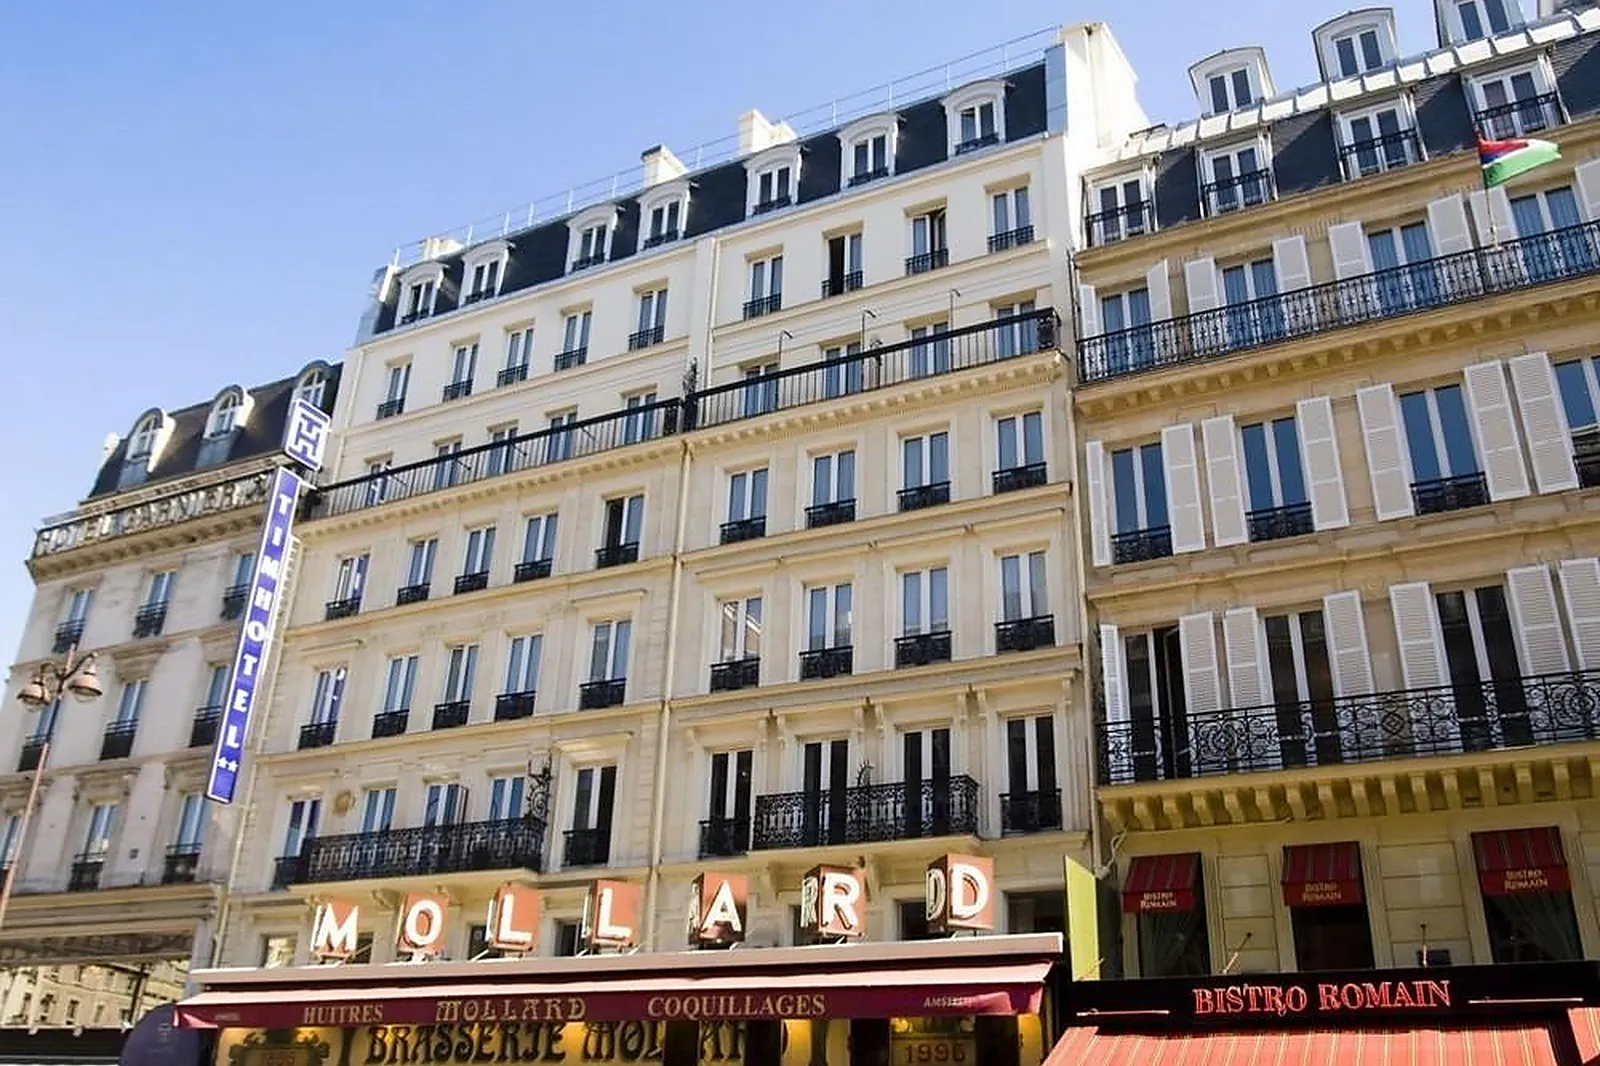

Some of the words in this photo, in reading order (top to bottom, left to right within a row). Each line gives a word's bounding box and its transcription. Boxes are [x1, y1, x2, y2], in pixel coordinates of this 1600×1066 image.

[226, 494, 292, 749] TIMHOTEL
[312, 863, 989, 951] MOLLARD
[303, 1003, 384, 1025] HUITRES
[435, 997, 588, 1022] MOLLARD
[647, 994, 827, 1018] COQUILLAGES
[1192, 983, 1307, 1017] BISTRO
[1318, 980, 1451, 1010] ROMAIN
